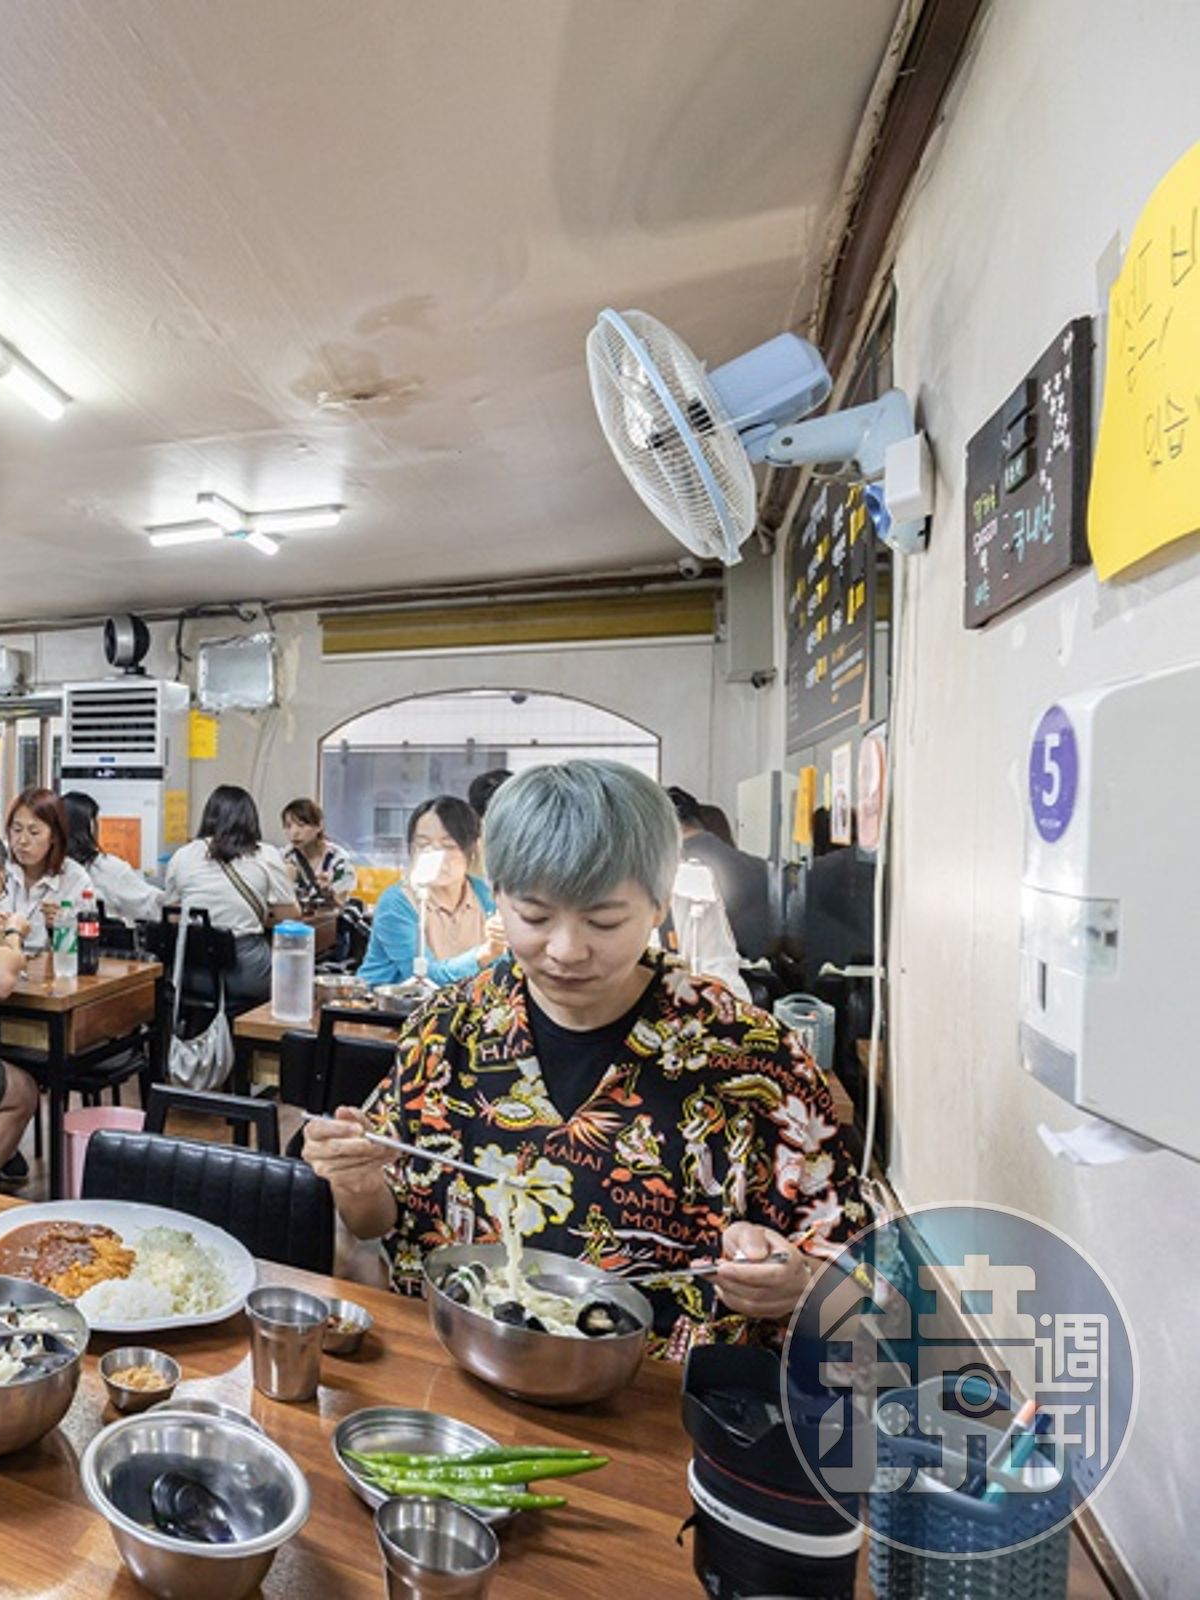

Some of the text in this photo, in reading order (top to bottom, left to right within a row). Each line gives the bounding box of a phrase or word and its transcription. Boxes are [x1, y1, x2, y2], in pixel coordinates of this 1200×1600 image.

[1012, 493, 1056, 563] 국내산
[1042, 732, 1061, 806] 5
[543, 1142, 603, 1172] KAUAI
[610, 1185, 675, 1216] OAHU
